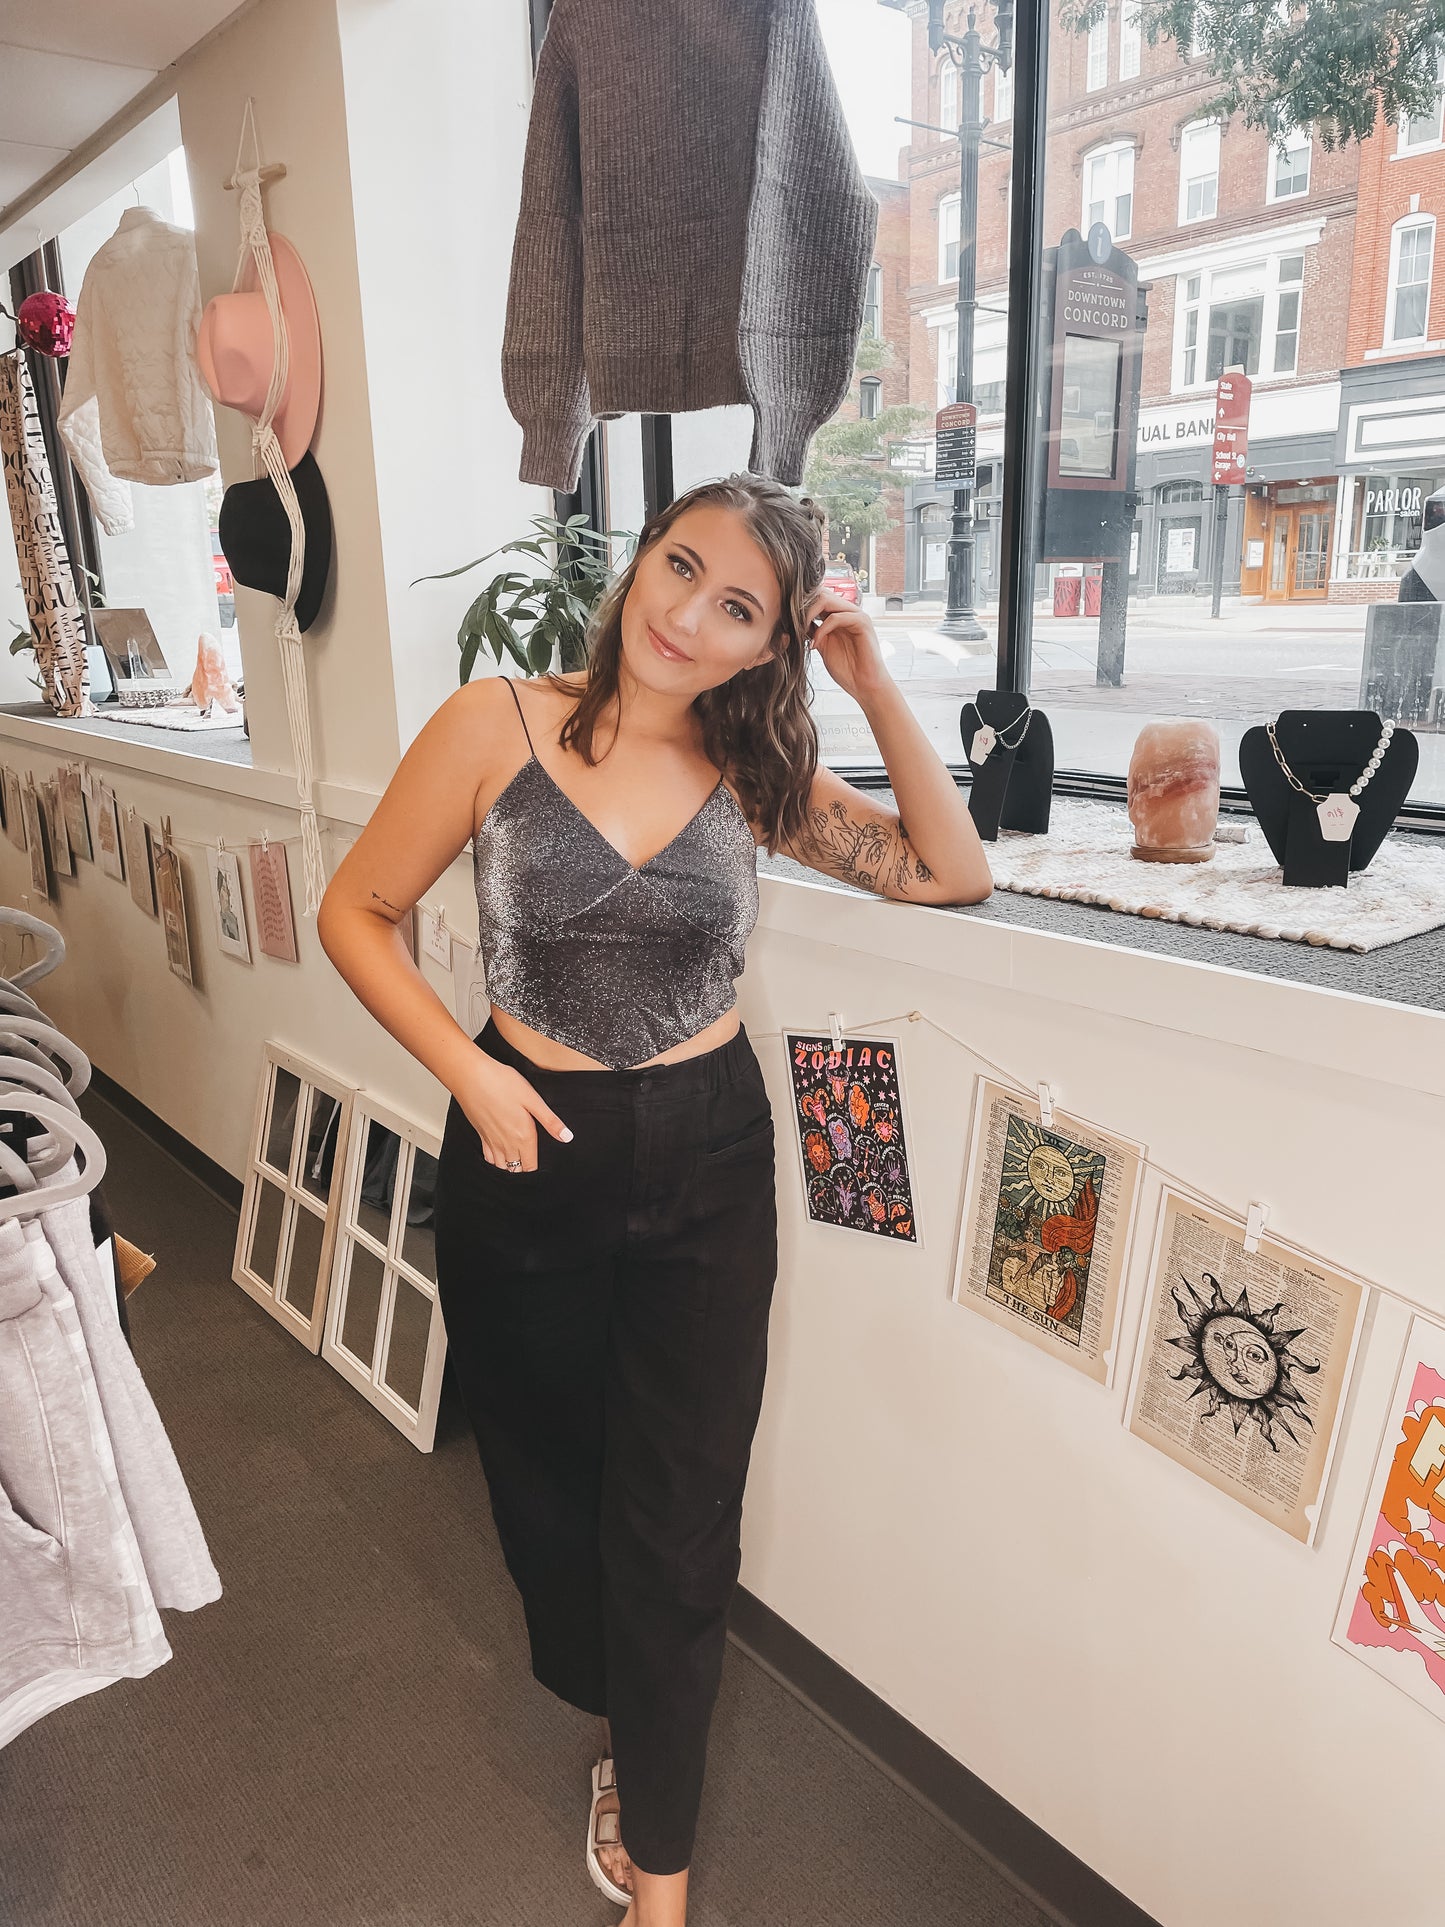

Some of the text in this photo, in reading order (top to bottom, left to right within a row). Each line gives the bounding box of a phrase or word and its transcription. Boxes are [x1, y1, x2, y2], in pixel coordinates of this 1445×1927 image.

[1083, 271, 1097, 280] EST.
[1067, 289, 1126, 309] DOWNTOWN
[1063, 306, 1129, 329] CONCORD
[941, 418, 971, 428] CONCORD
[1366, 487, 1422, 514] PARLOR
[1399, 509, 1420, 518] salon
[795, 1041, 823, 1053] SIGNS
[794, 1047, 892, 1070] ZODIAC
[1003, 1292, 1029, 1316] THE
